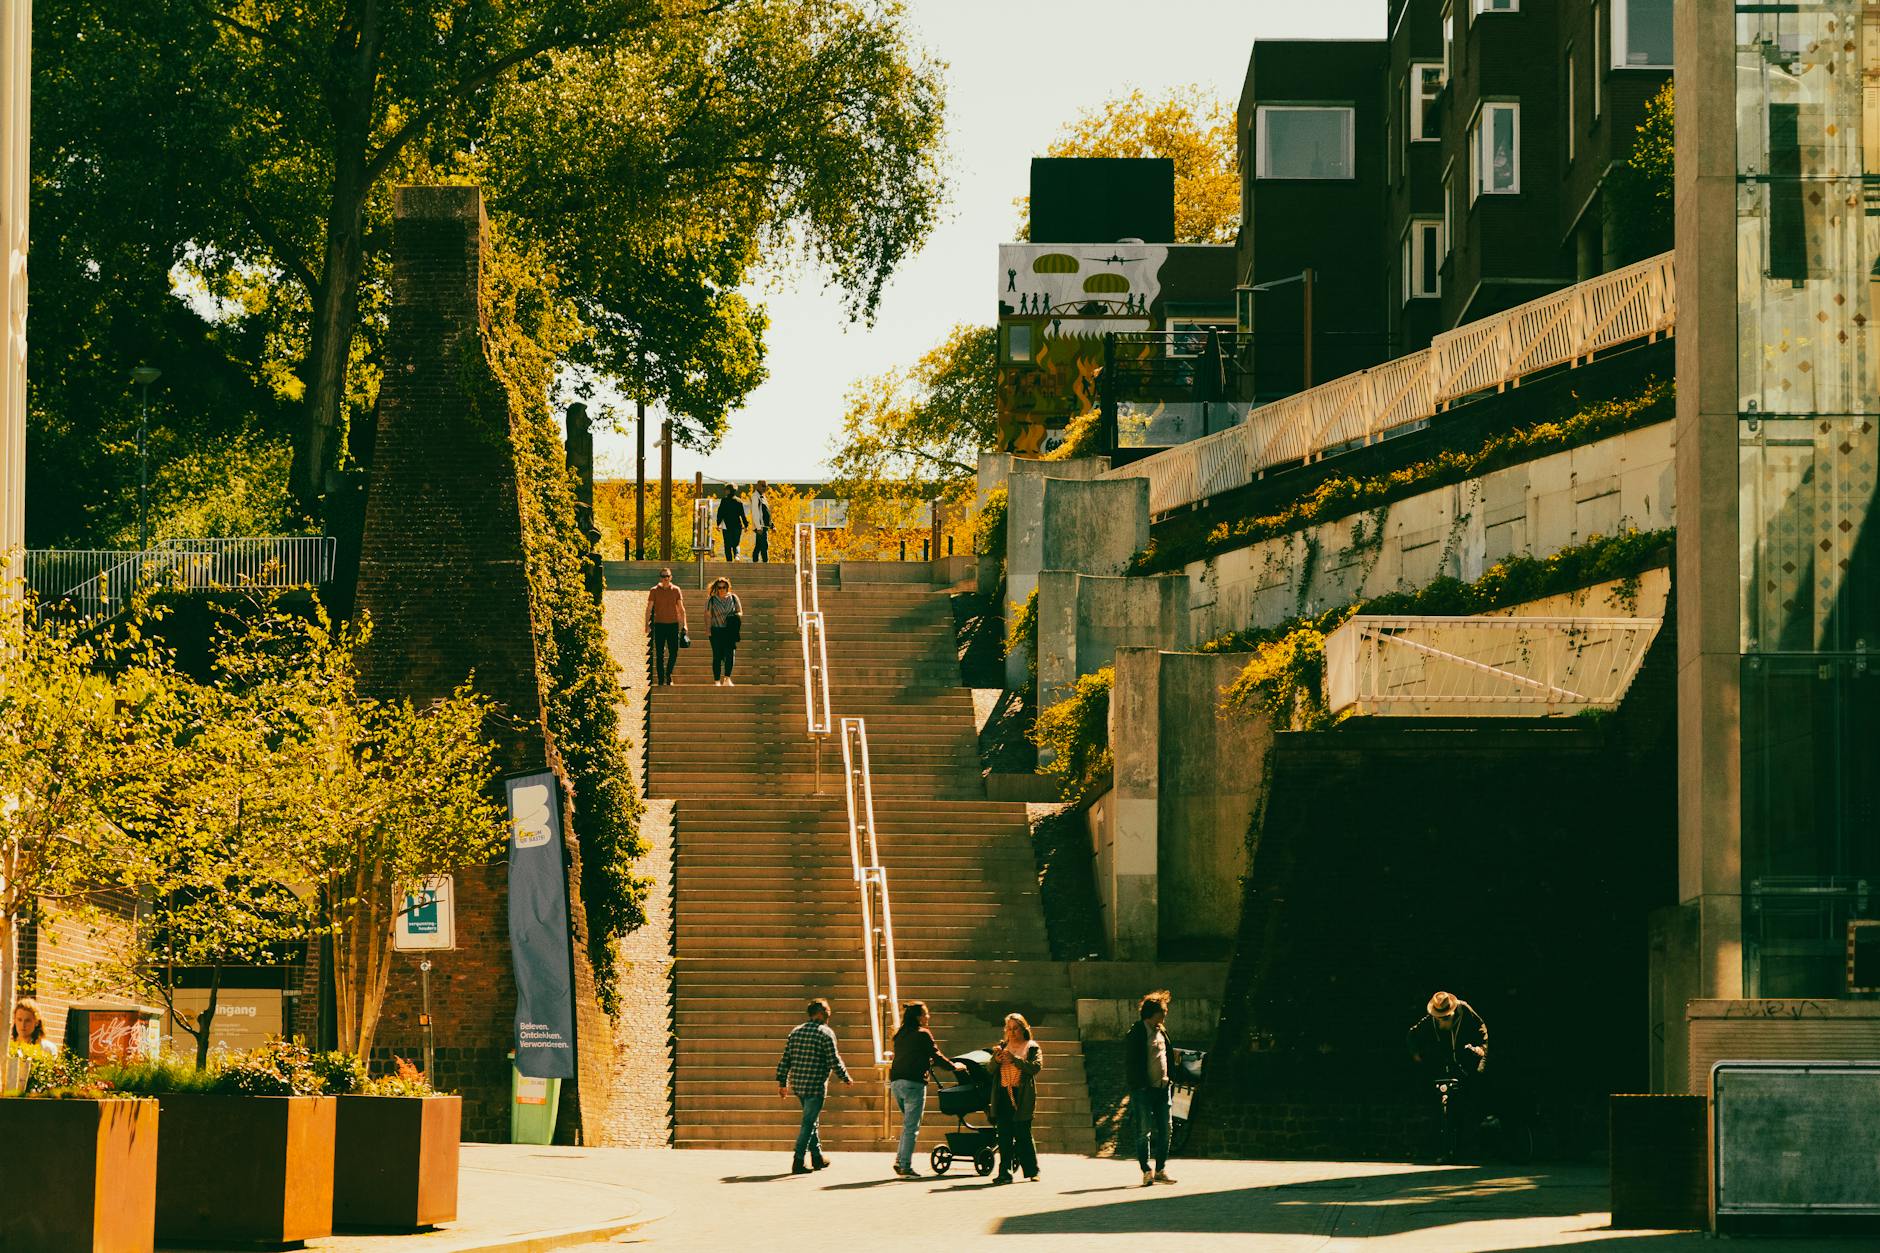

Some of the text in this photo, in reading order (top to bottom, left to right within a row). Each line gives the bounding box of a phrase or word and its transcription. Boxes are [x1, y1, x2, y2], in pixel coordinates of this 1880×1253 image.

[413, 892, 431, 917] P
[520, 1022, 549, 1030] Beleven.
[520, 1031, 562, 1039] Ontdekken.
[520, 1040, 569, 1048] Verwonderen.
